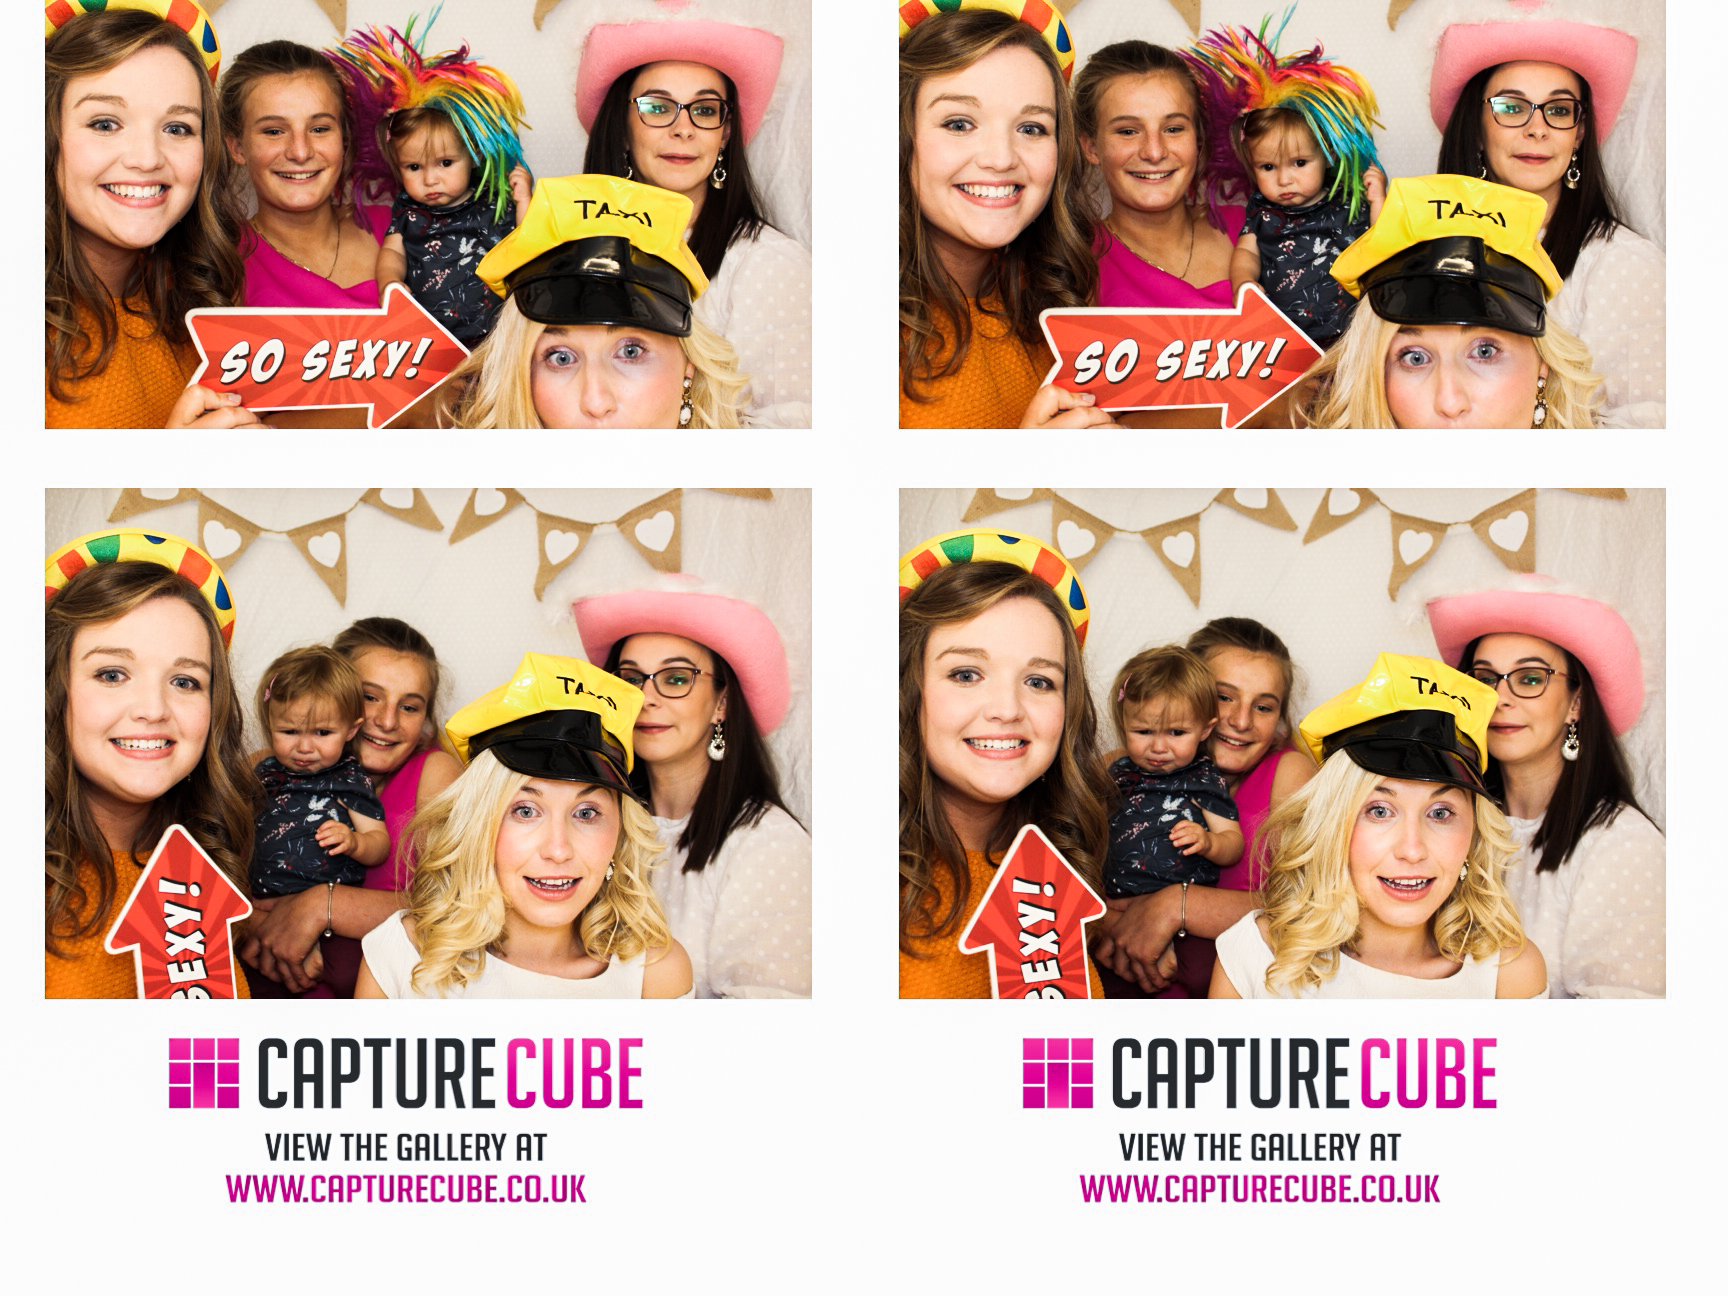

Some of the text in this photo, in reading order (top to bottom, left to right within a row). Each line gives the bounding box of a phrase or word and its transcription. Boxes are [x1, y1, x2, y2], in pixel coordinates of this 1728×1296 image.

[220, 338, 434, 385] SO SEXY!
[1074, 338, 1288, 385] SO SEXY!
